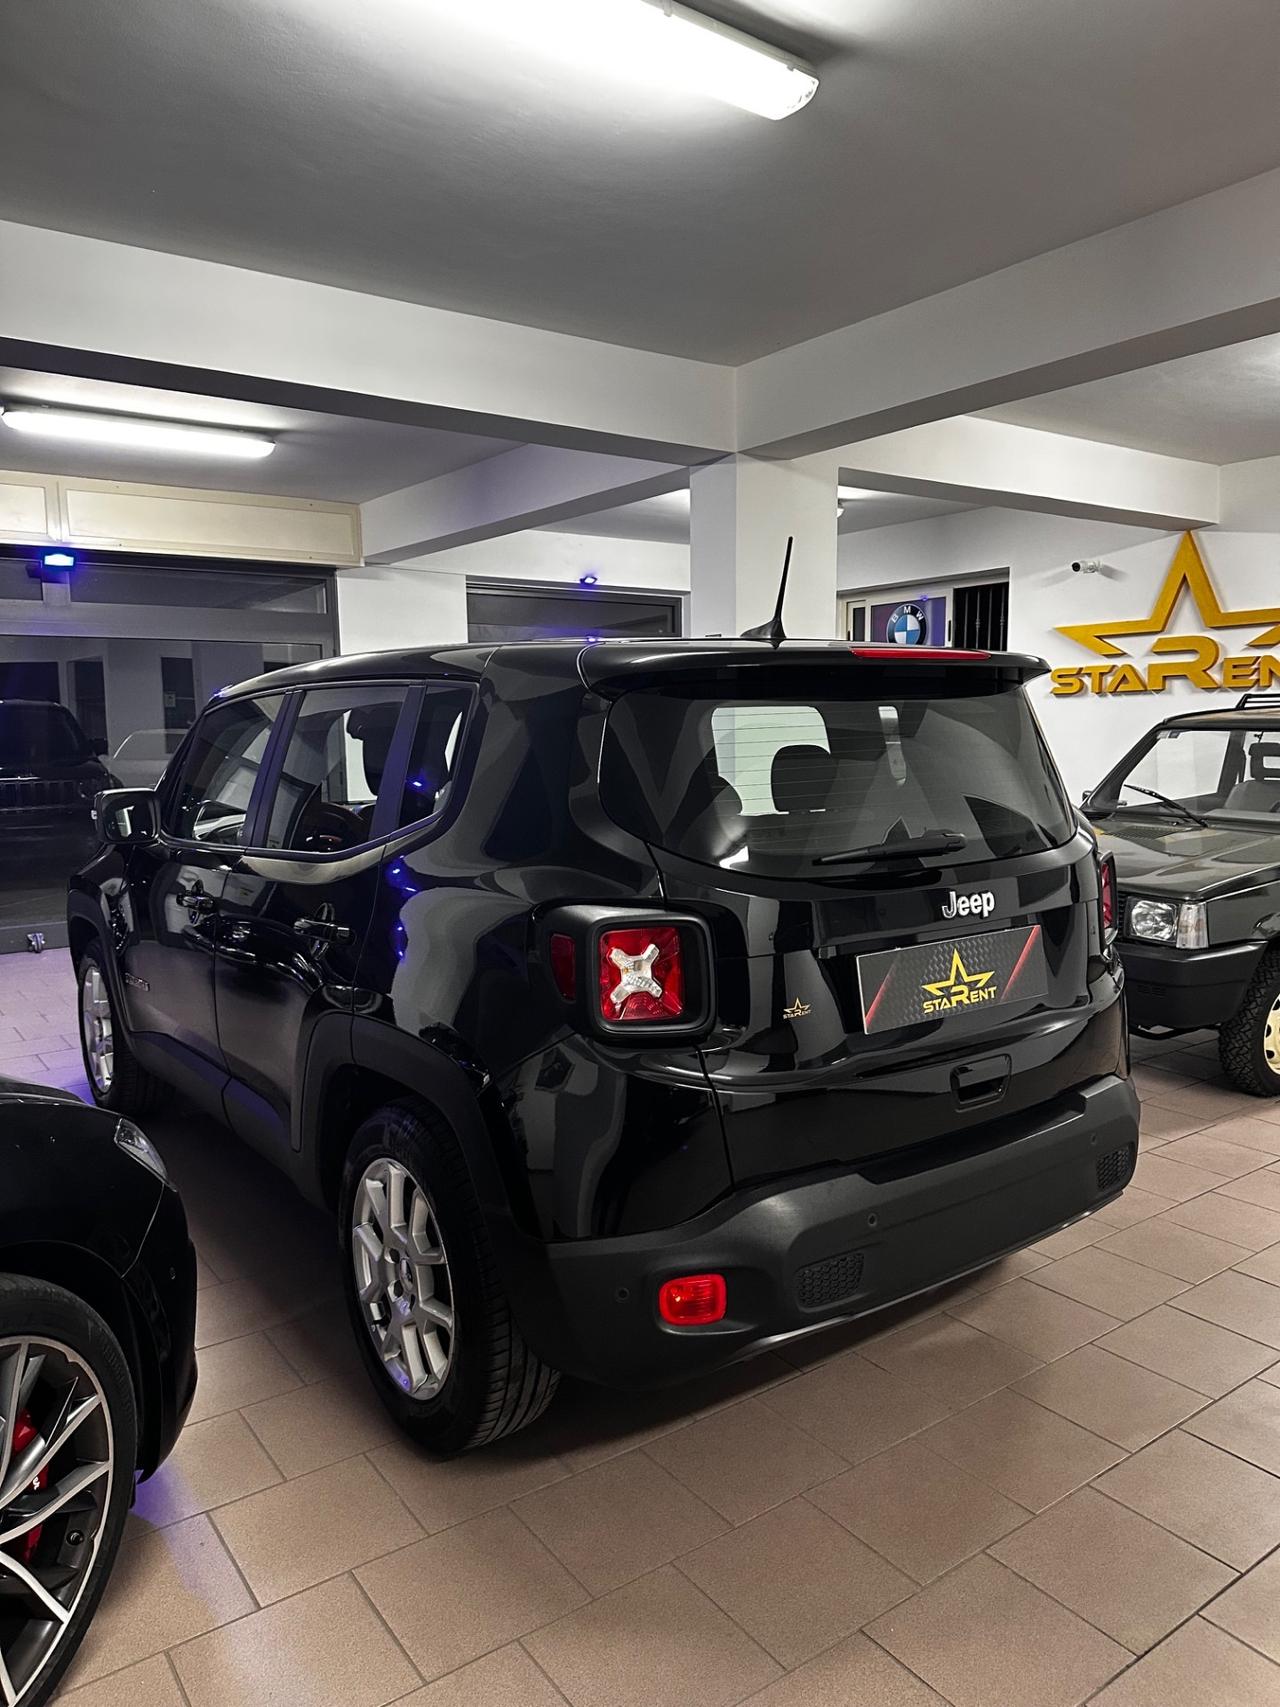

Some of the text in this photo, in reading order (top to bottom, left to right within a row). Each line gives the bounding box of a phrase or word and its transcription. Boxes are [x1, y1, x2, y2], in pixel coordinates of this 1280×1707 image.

[891, 605, 924, 624] BMW
[941, 891, 995, 919] Jeep
[922, 985, 998, 1014] STARENT
